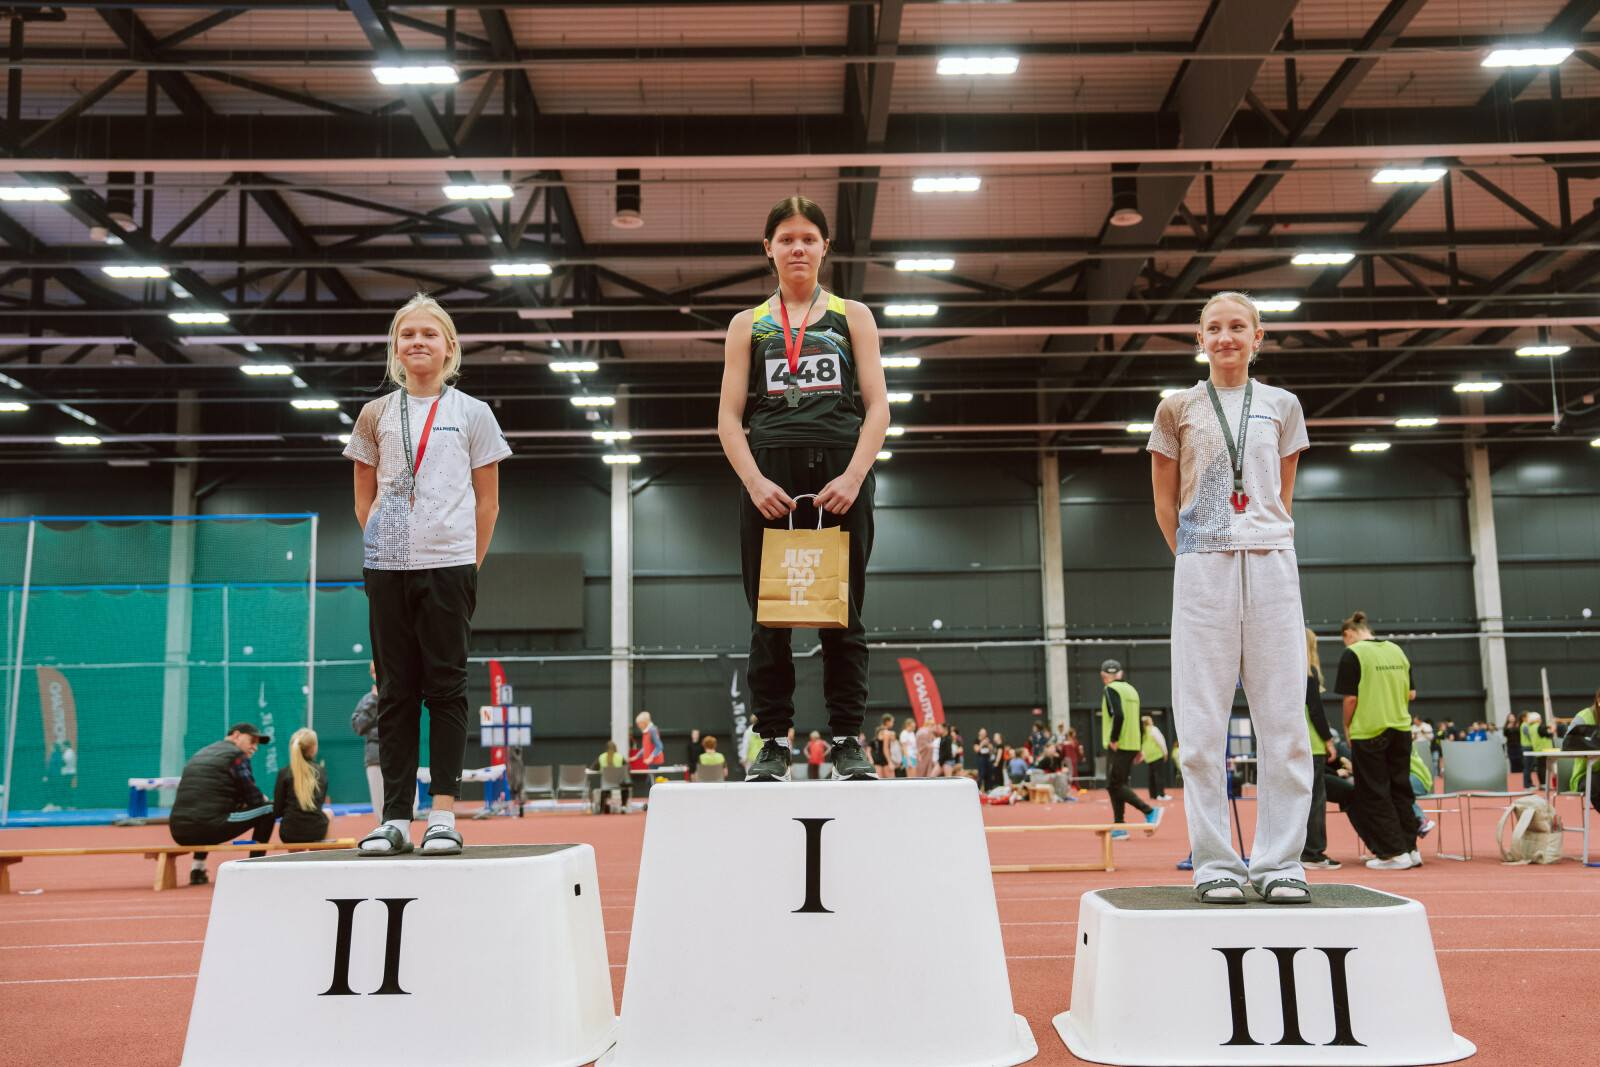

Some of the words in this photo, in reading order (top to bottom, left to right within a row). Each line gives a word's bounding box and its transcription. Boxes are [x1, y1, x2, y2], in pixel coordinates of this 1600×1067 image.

[771, 358, 837, 385] 448
[781, 549, 823, 568] JUST
[787, 567, 815, 586] DO
[790, 818, 835, 913] I
[317, 898, 418, 995] II
[1211, 947, 1368, 1047] III
